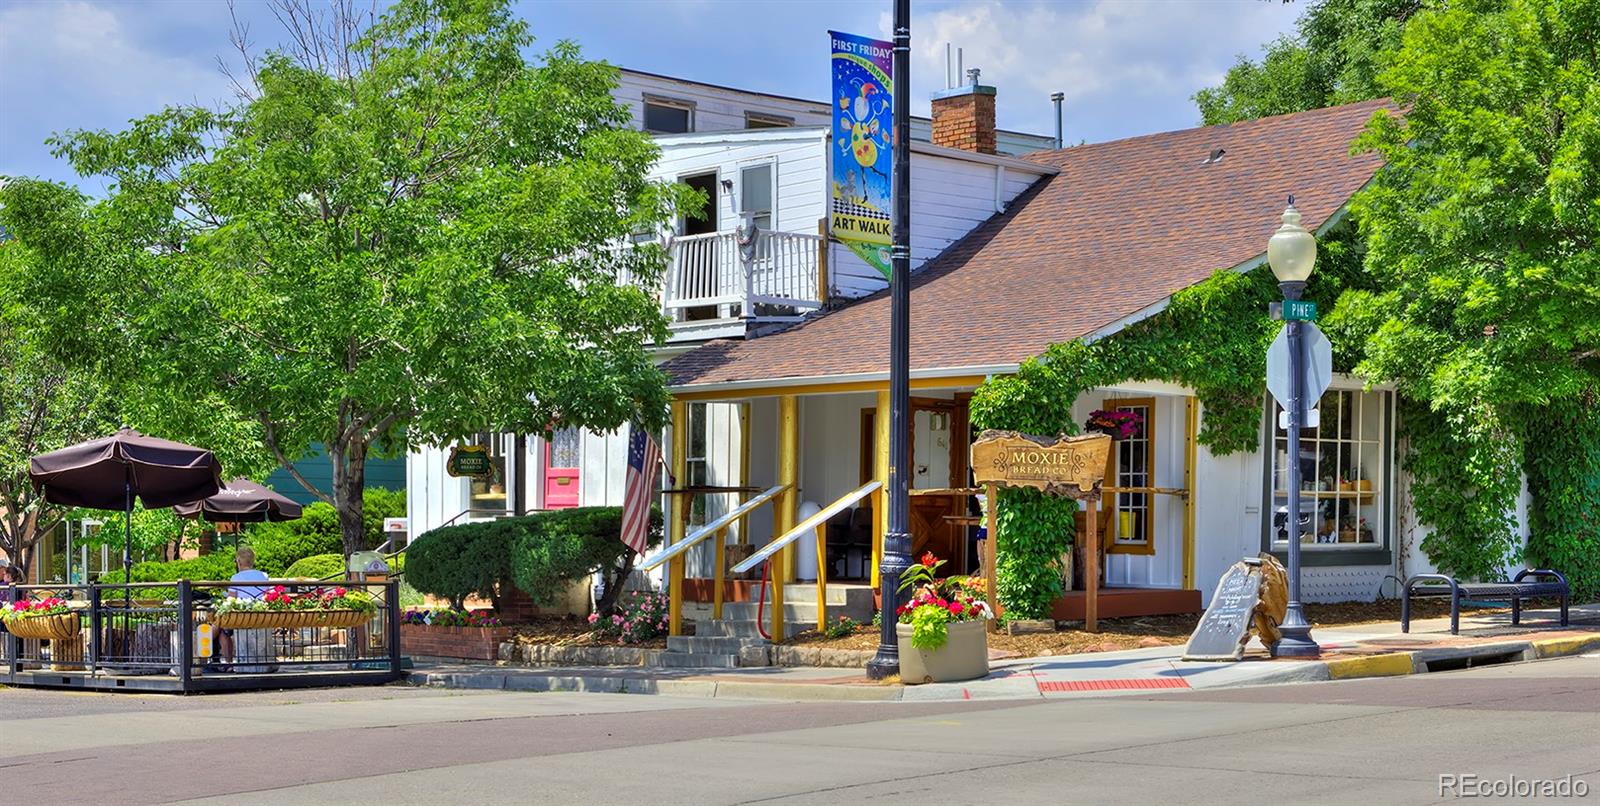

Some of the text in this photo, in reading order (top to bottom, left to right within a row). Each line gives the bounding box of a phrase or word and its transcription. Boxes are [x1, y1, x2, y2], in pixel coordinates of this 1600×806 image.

[832, 39, 891, 58] FIRST FRIDAY
[868, 64, 890, 88] shops
[833, 216, 890, 235] ART WALK
[1291, 303, 1309, 317] PINE
[1012, 452, 1069, 465] MOXIE
[1013, 466, 1049, 474] BREAD
